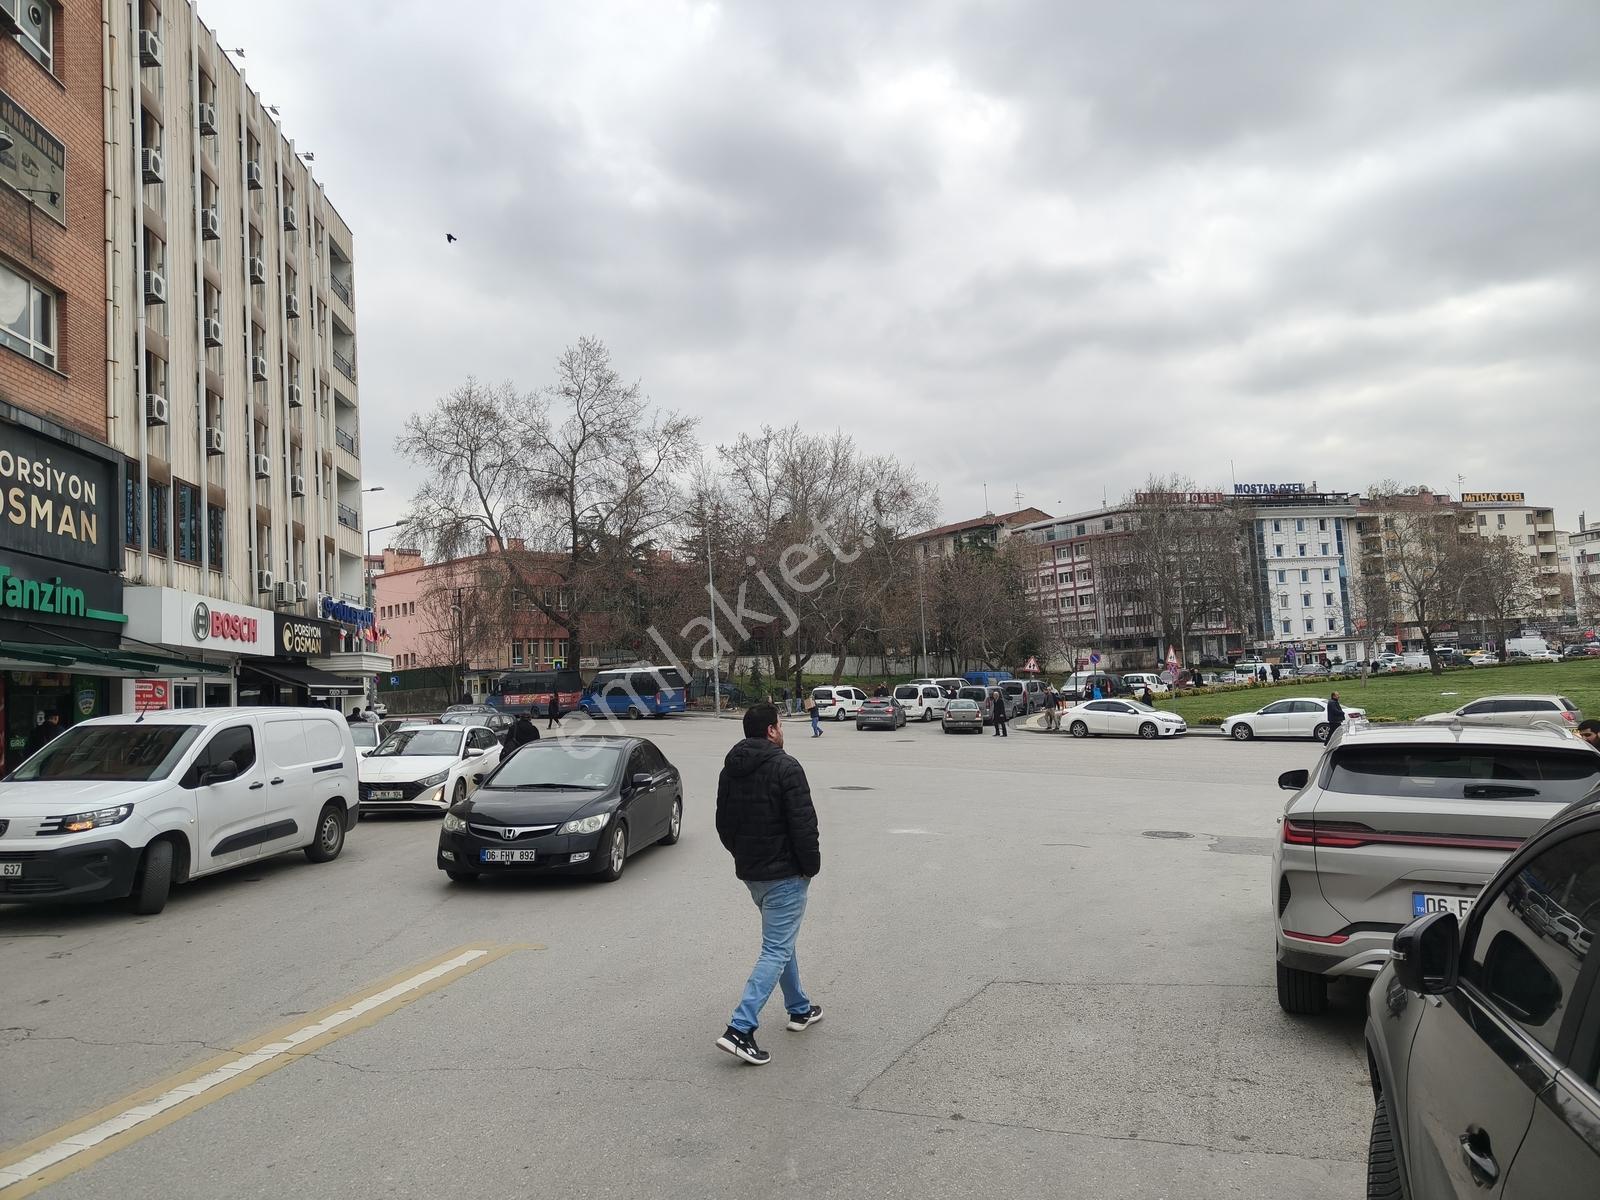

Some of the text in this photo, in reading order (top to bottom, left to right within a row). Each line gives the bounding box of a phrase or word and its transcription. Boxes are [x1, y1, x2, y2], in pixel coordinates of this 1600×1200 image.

[1234, 483, 1305, 494] MOSTAR OTEL
[1191, 493, 1222, 503] OTEL
[1501, 492, 1525, 502] OTEL
[0, 486, 97, 545] SMAN
[0, 565, 85, 617] Tanzim
[211, 610, 258, 643] BOSCH
[294, 622, 322, 639] PORSİYON
[294, 637, 322, 654] OSMAN
[486, 850, 534, 860] 06 FHV 892
[3, 864, 21, 875] 637
